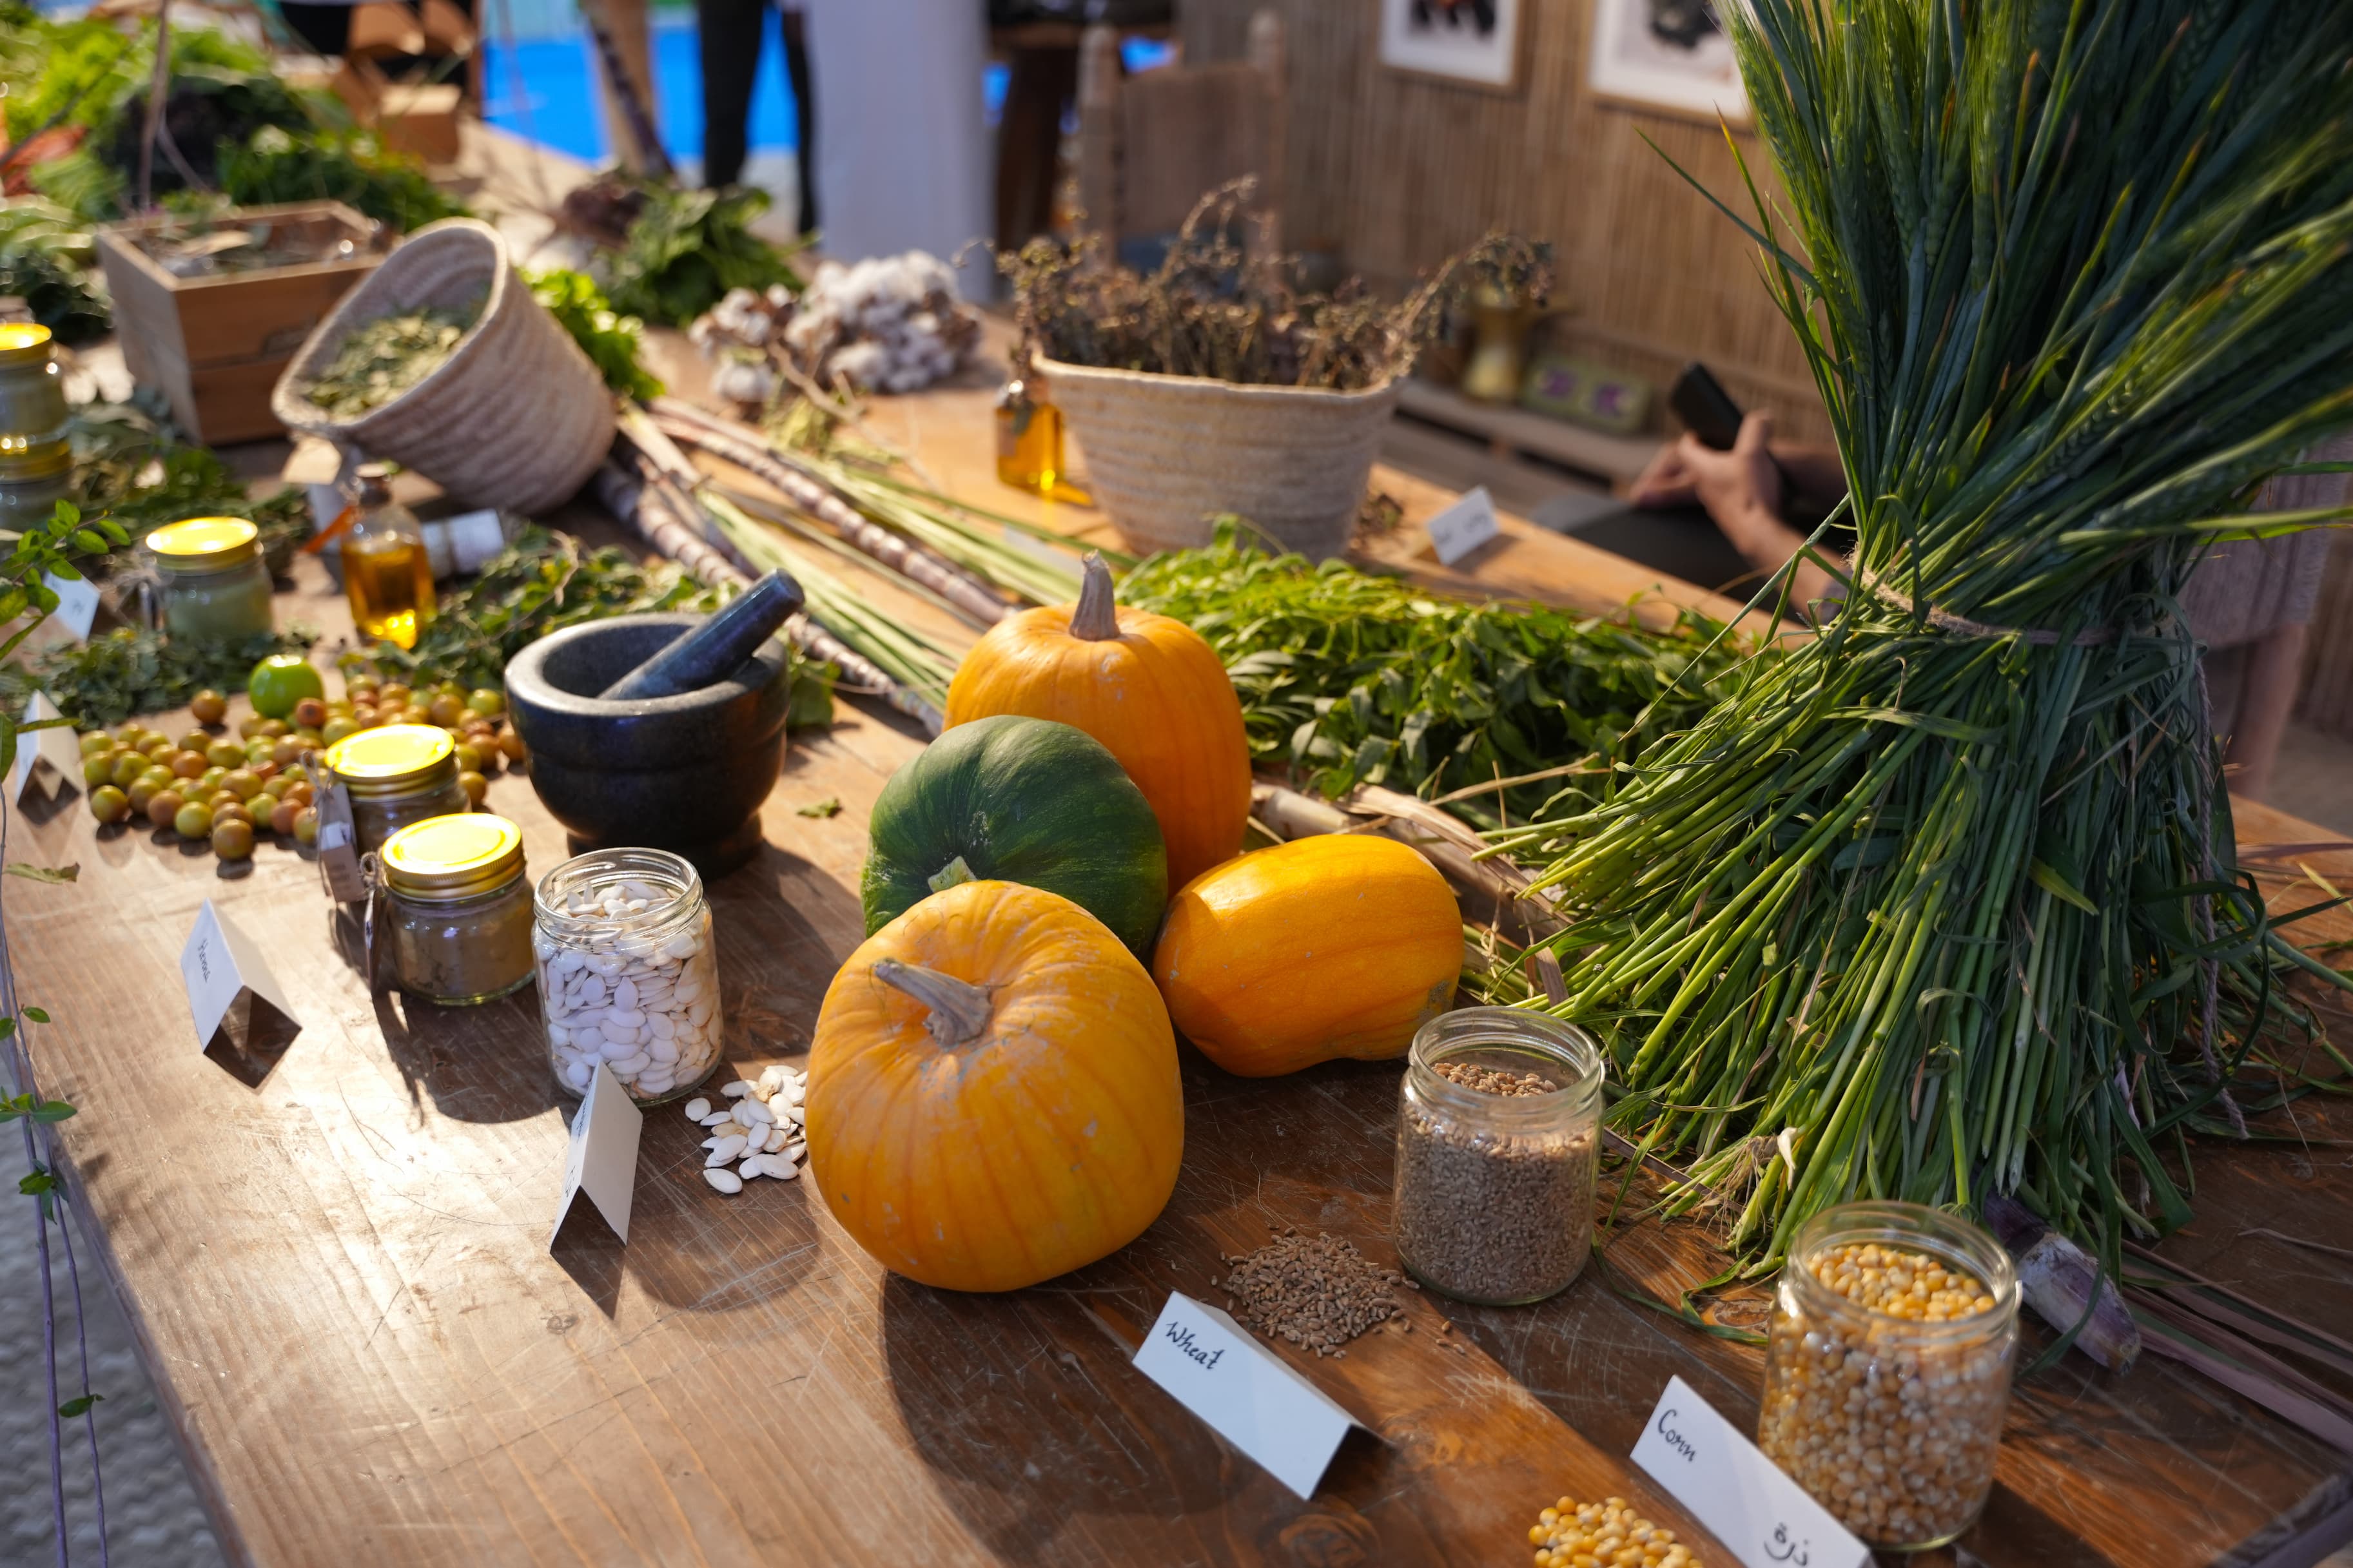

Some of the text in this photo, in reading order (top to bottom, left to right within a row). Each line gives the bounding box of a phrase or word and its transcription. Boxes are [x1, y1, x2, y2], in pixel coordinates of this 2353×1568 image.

[1166, 1321, 1225, 1371] Wheat
[1657, 1409, 1697, 1462] Corn
[1764, 1522, 1808, 1567] ذرة
